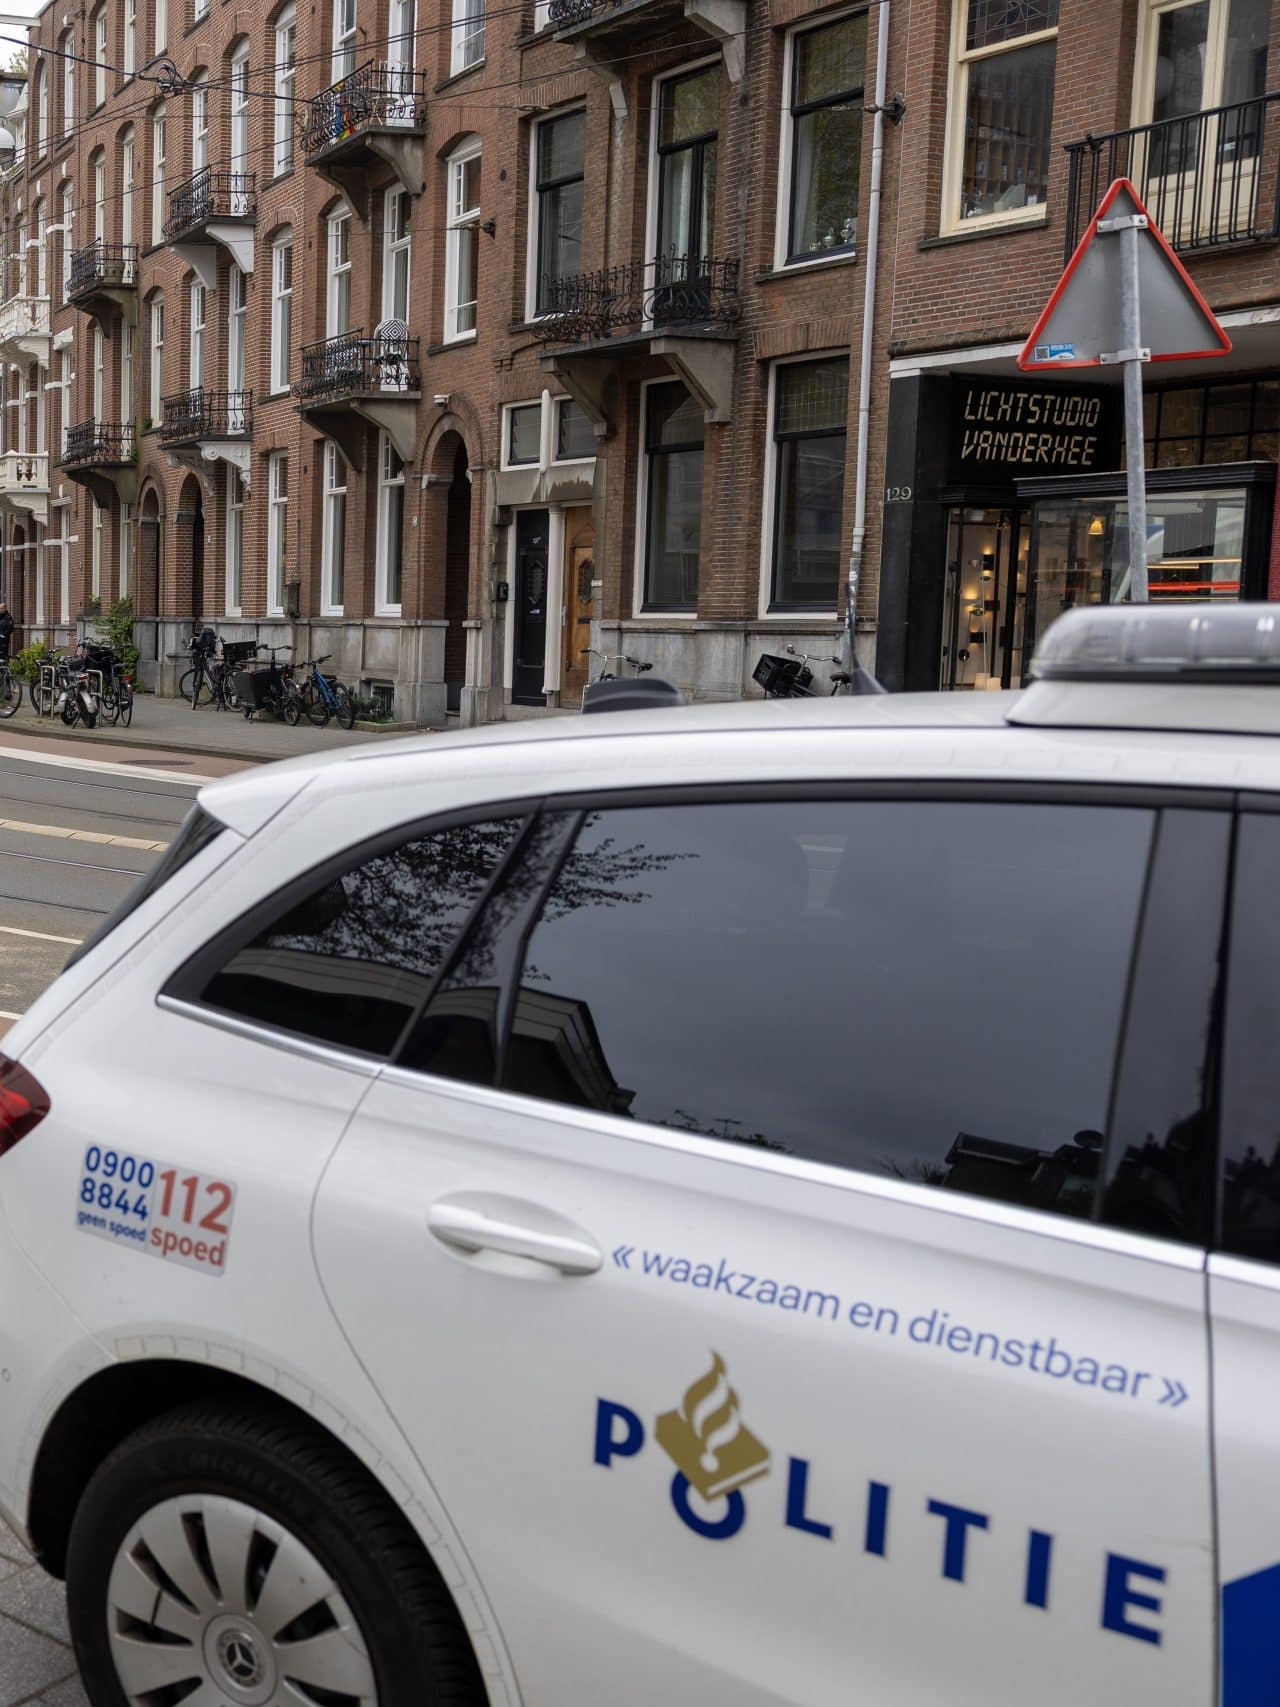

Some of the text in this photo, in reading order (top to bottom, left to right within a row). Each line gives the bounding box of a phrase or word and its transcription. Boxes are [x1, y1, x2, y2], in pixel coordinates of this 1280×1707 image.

[964, 390, 1101, 428] LICHTSTUDIO
[961, 430, 1098, 465] VANDERHEE
[886, 486, 912, 502] 129
[85, 1146, 155, 1188] 0900
[80, 1177, 149, 1221] 8844
[160, 1169, 233, 1235] 112
[77, 1210, 146, 1242] geen spoed
[151, 1227, 225, 1267] spoed
[641, 1250, 841, 1321] waakzaam
[848, 1300, 900, 1335] en
[908, 1308, 1152, 1398] dienstbaar
[593, 1397, 1169, 1648] POLITIE
